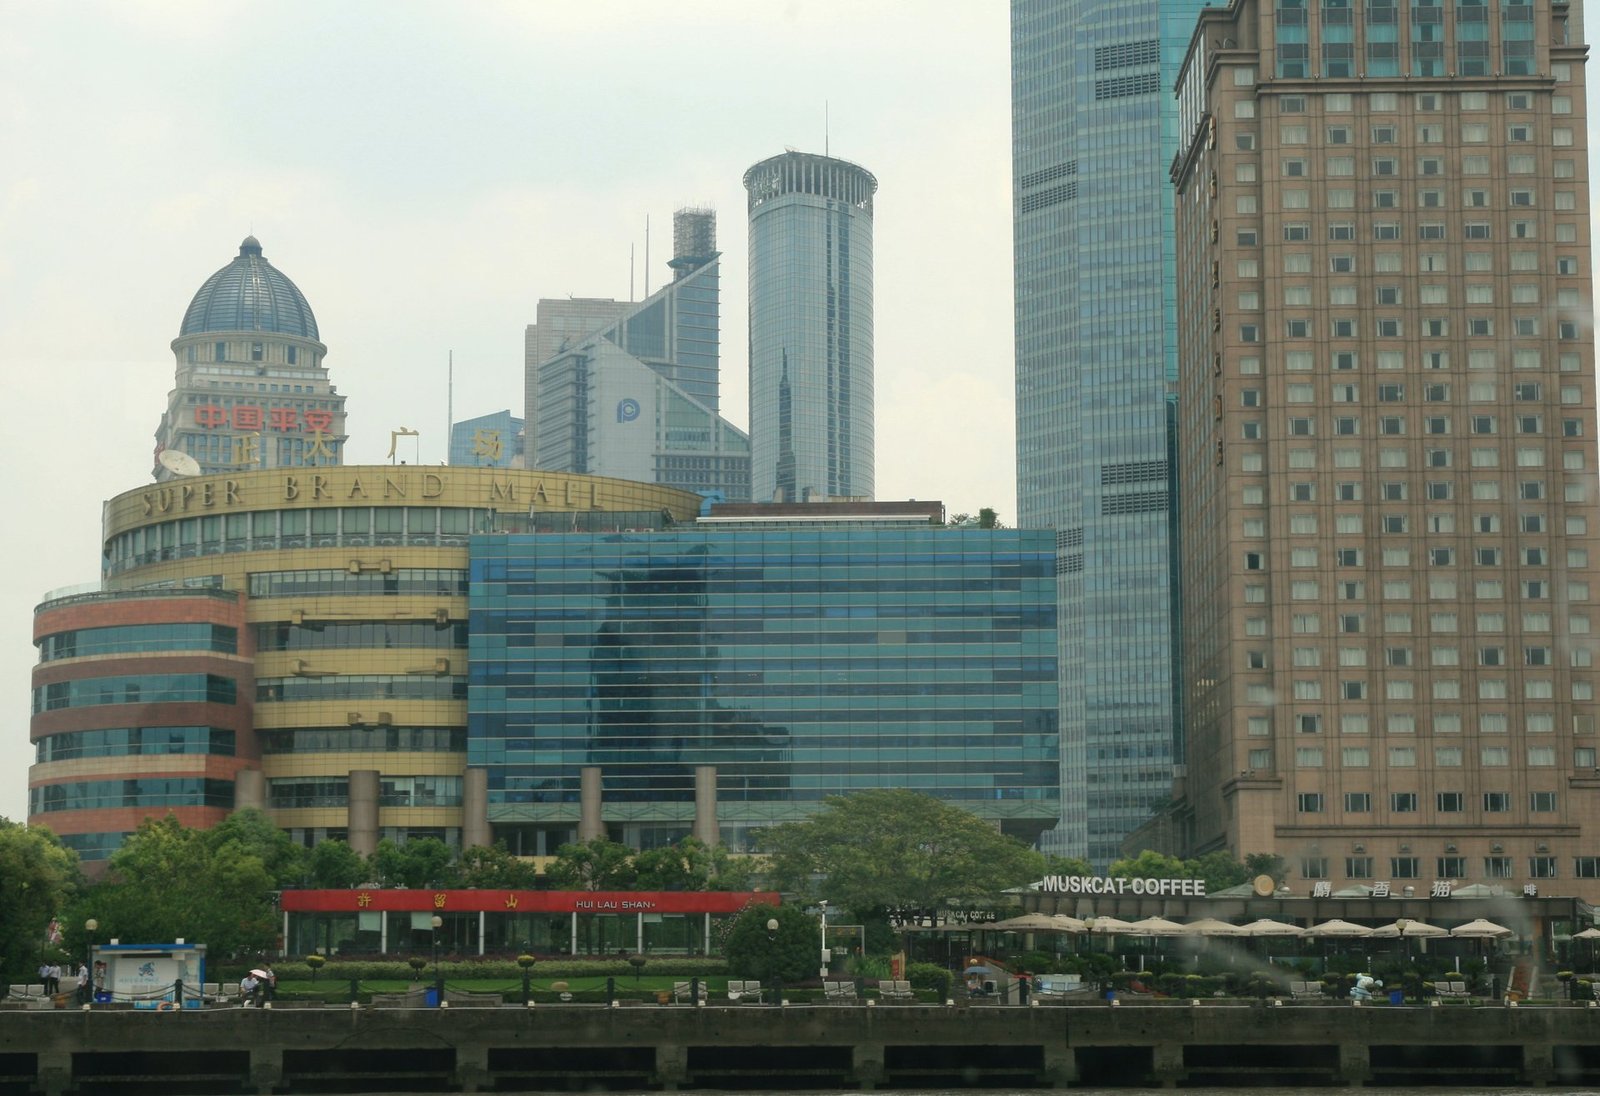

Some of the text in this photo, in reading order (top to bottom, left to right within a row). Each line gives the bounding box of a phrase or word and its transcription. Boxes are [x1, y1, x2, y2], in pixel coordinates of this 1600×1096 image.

[195, 404, 333, 433] 中国平安
[143, 473, 604, 516] SUPER BRAND MALL
[1043, 875, 1206, 896] MUSKCAT COFFEE
[597, 901, 617, 909] LAU
